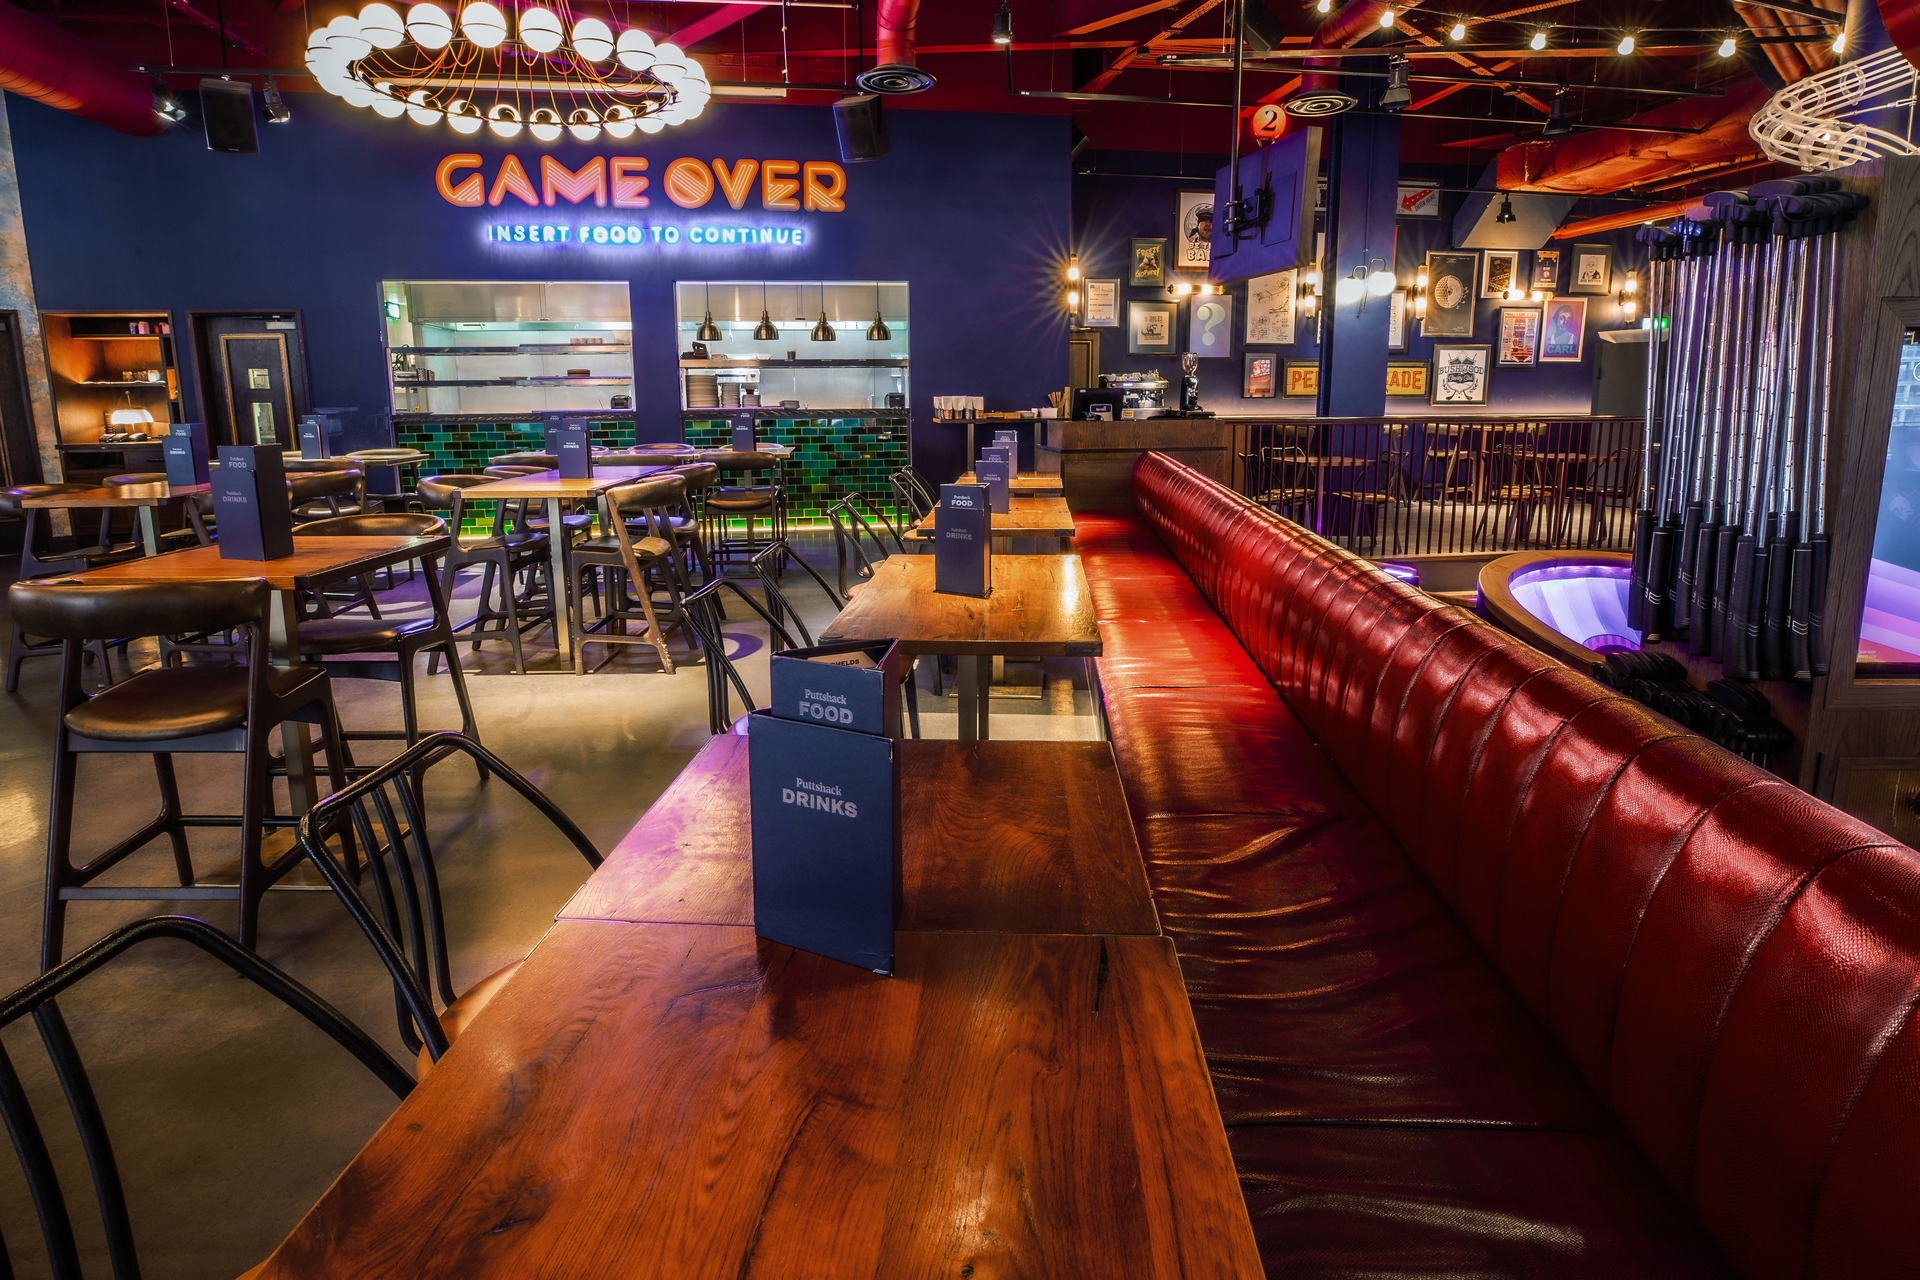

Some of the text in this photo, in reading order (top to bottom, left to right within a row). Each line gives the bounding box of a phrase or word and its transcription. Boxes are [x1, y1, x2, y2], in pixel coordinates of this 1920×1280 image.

[1261, 109, 1278, 131] 2
[435, 153, 847, 213] GAME OVER
[487, 224, 804, 246] INSERT FOOD TO CONTINUE
[1136, 245, 1161, 259] FREEZE
[1546, 344, 1576, 354] CARL
[1438, 365, 1484, 375] BUSHWOOD
[1386, 370, 1422, 390] ADE
[228, 461, 247, 469] FOOD
[222, 495, 248, 503] DRINKS
[951, 499, 973, 507] FOOD
[946, 531, 973, 541] DRINKS
[804, 688, 847, 705] Puttshack
[798, 701, 854, 724] FOOD
[795, 777, 842, 796] Puttshack
[782, 788, 858, 819] DRINKS
